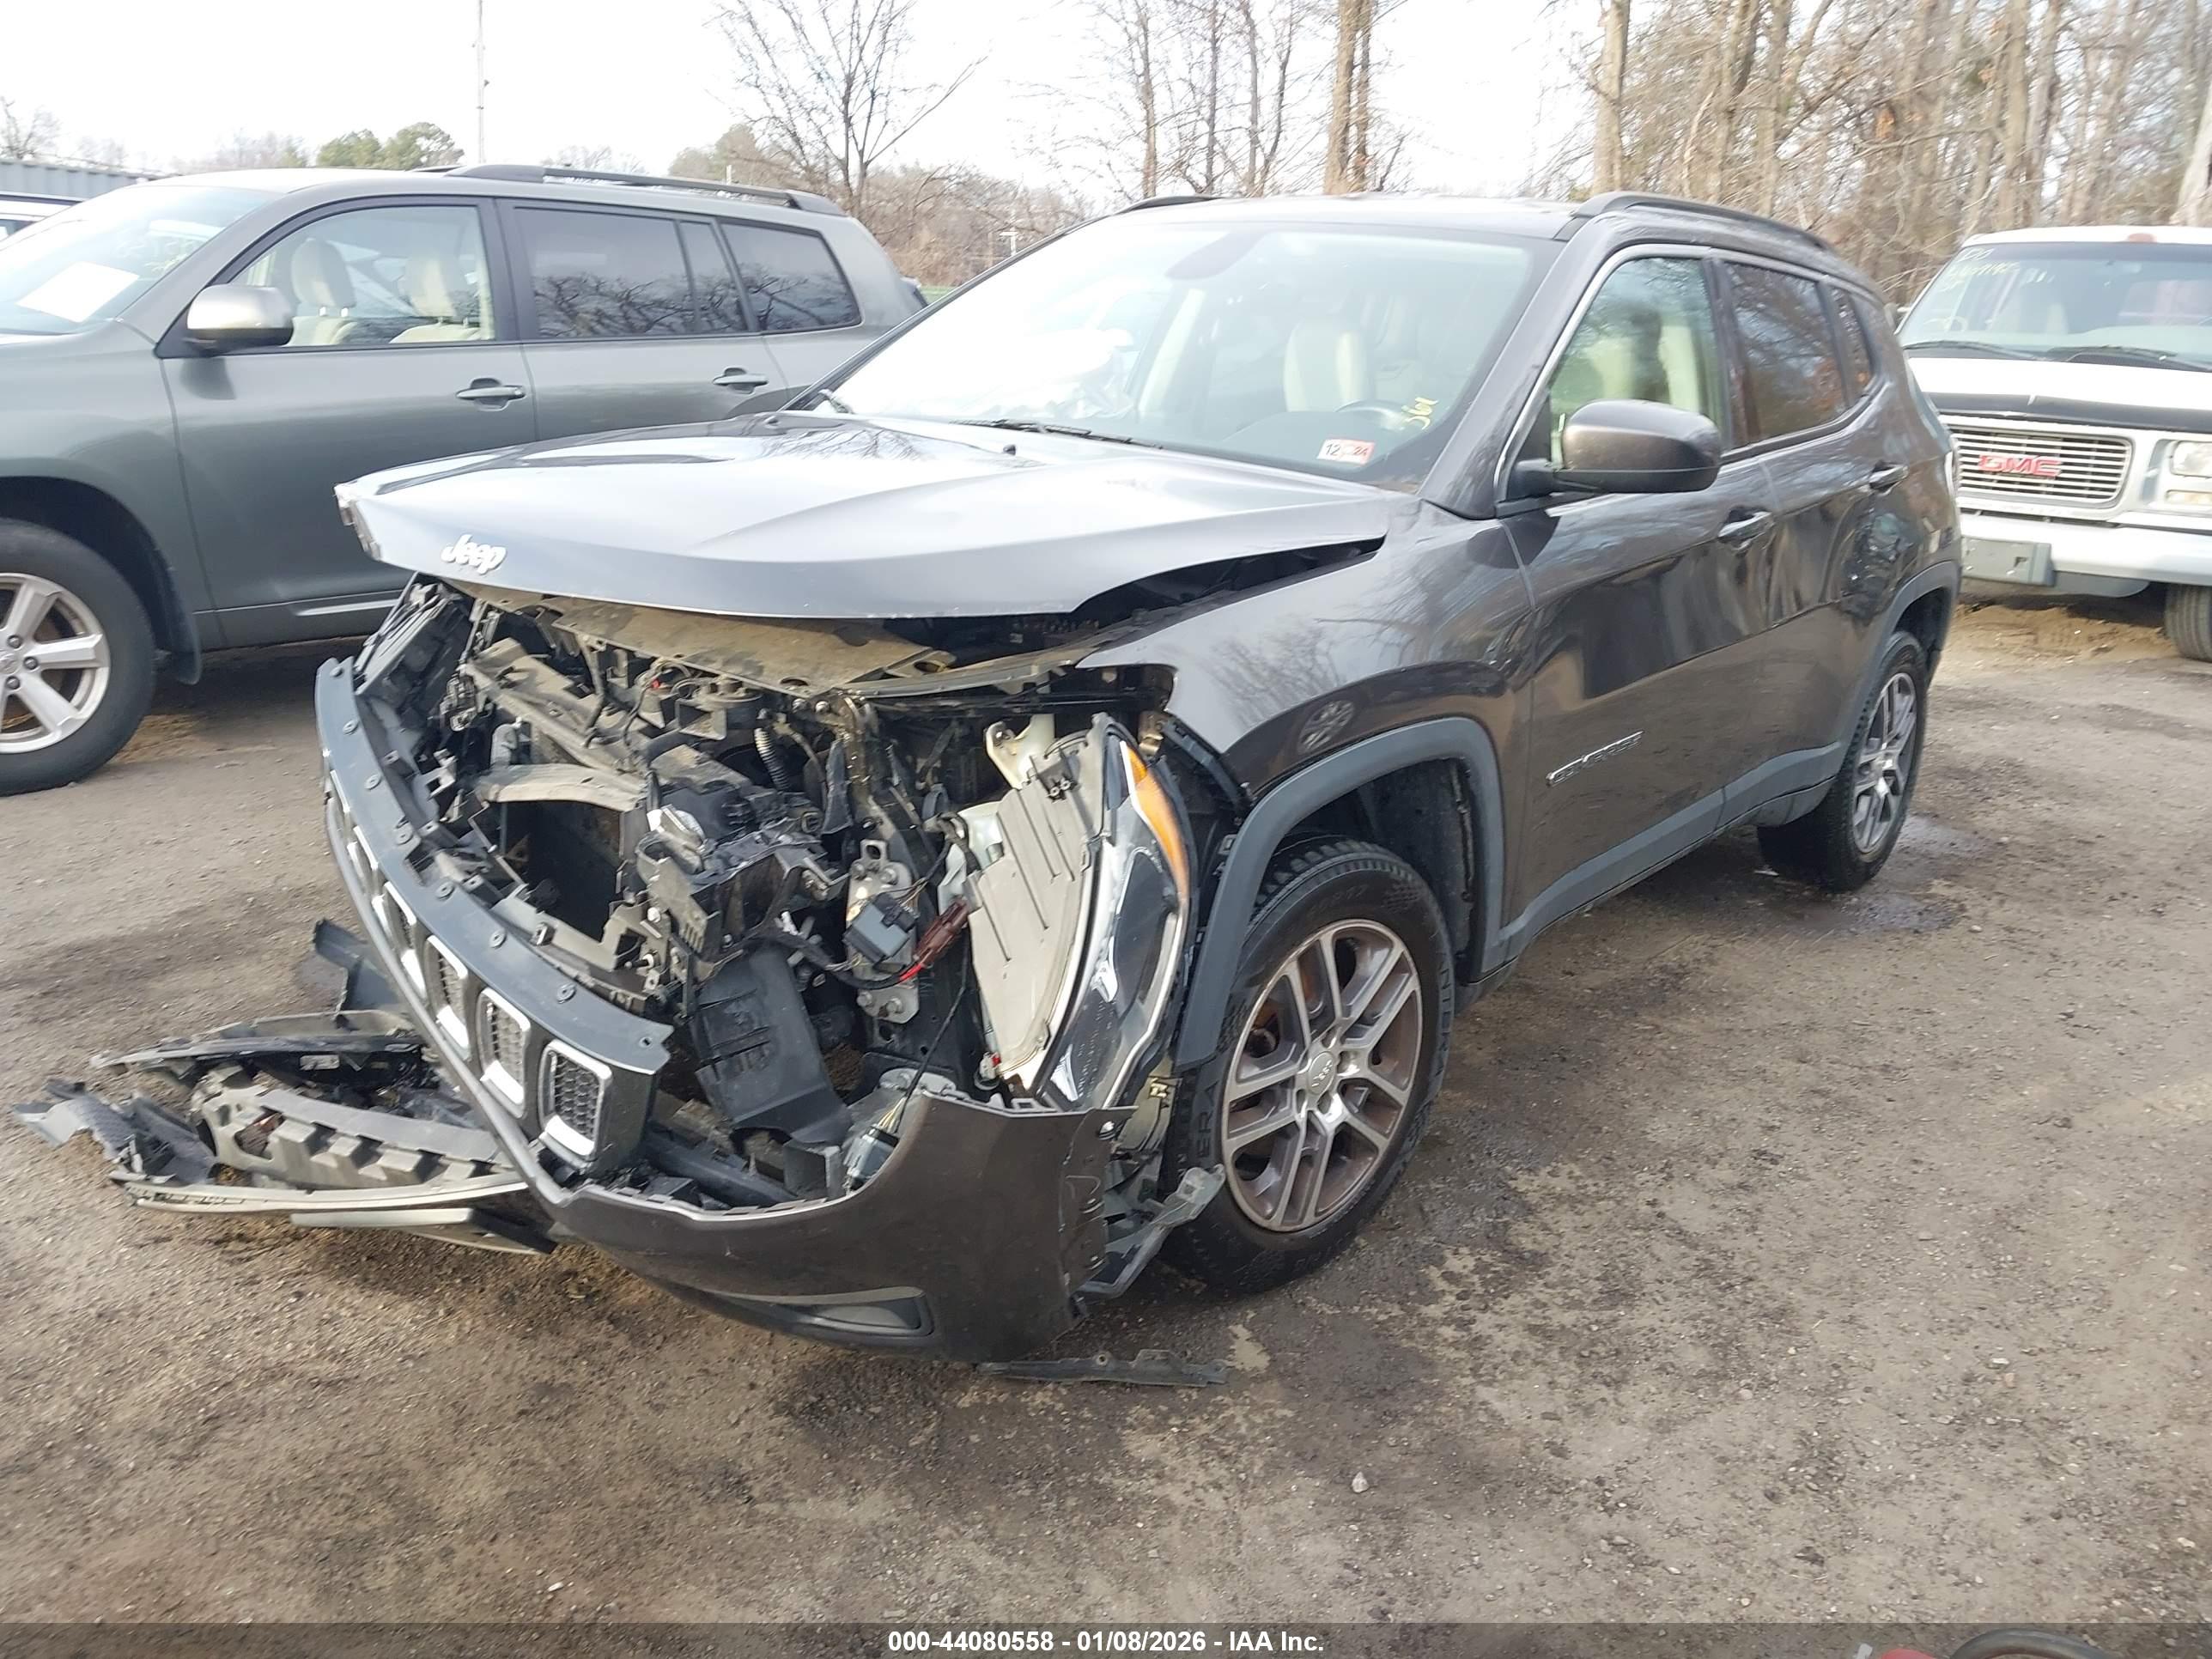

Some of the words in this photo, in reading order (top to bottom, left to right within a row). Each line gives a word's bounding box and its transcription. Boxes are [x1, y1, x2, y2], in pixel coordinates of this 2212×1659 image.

[1325, 443, 1341, 457] 12
[1978, 453, 2062, 478] GMC
[441, 533, 507, 574] Jeep
